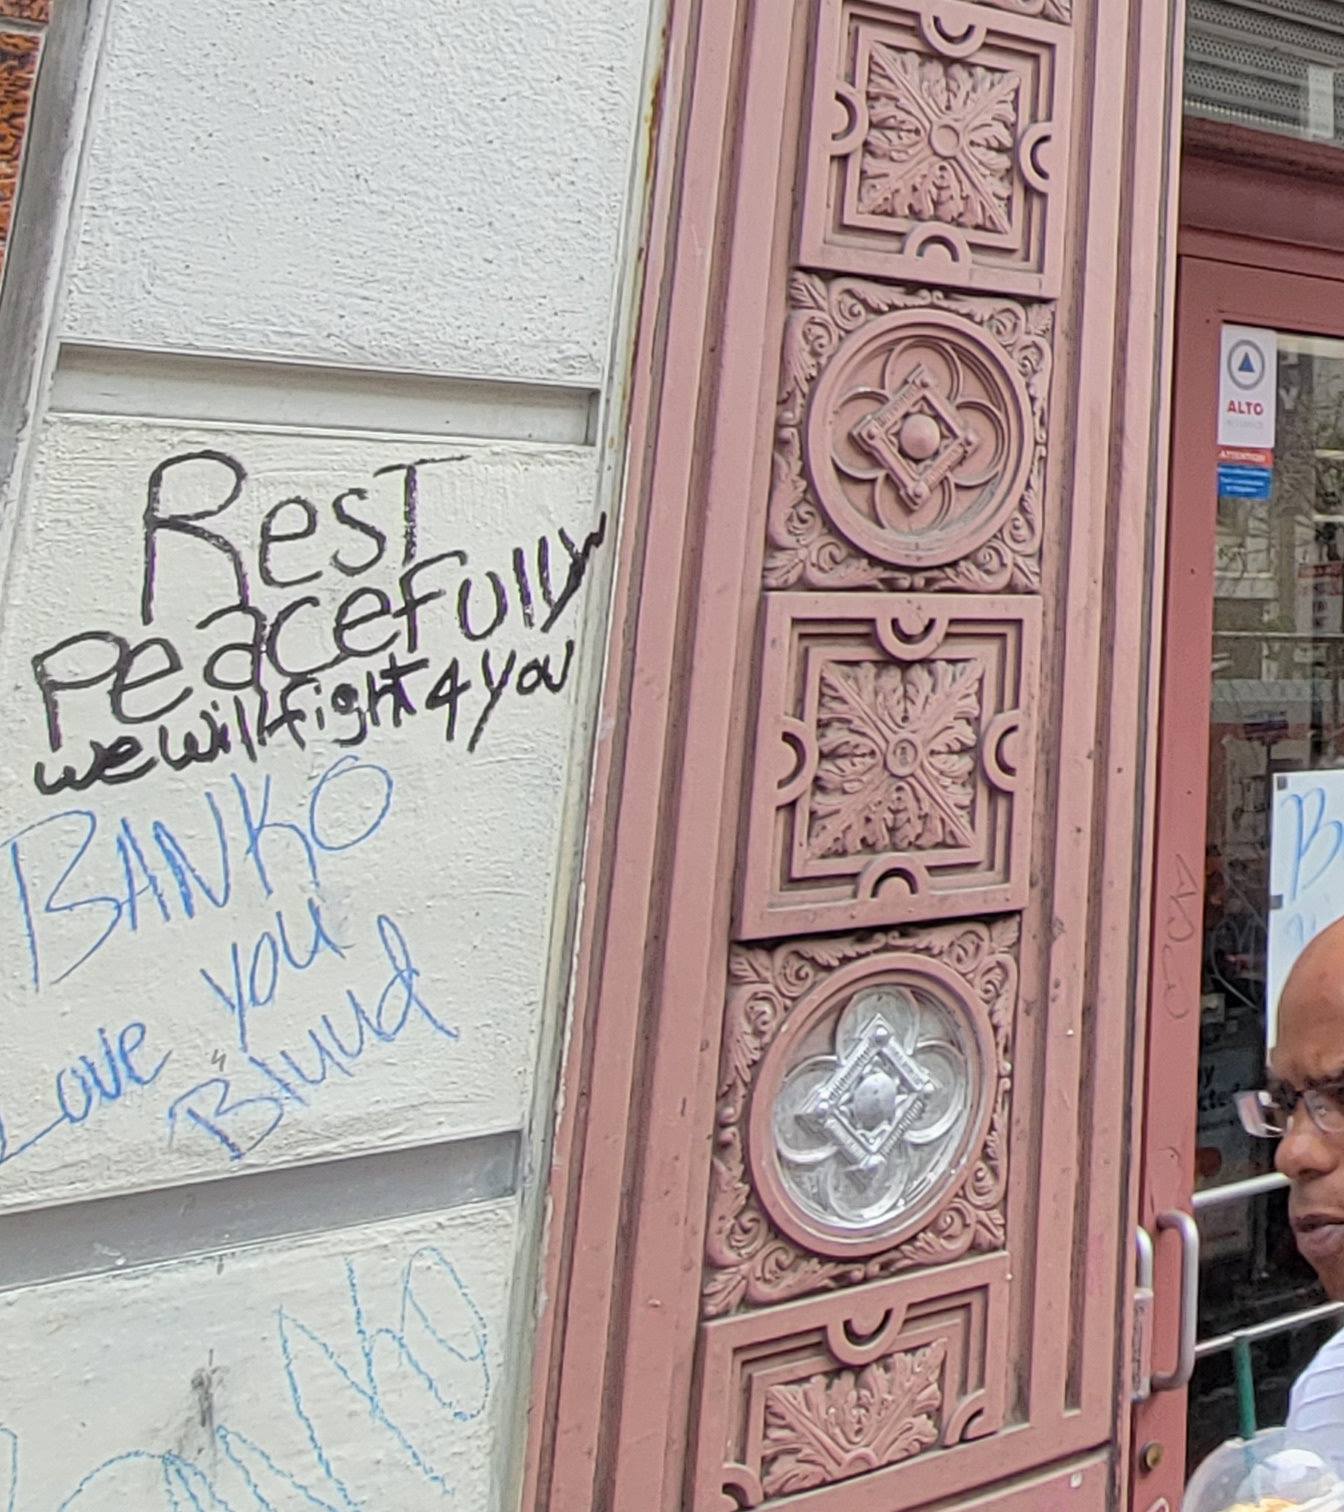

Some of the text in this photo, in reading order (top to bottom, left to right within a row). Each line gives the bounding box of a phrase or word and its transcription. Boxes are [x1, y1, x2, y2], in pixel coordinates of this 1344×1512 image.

[1227, 399, 1264, 416] ALTO
[425, 657, 471, 742] 4
[0, 754, 394, 993] BANKO
